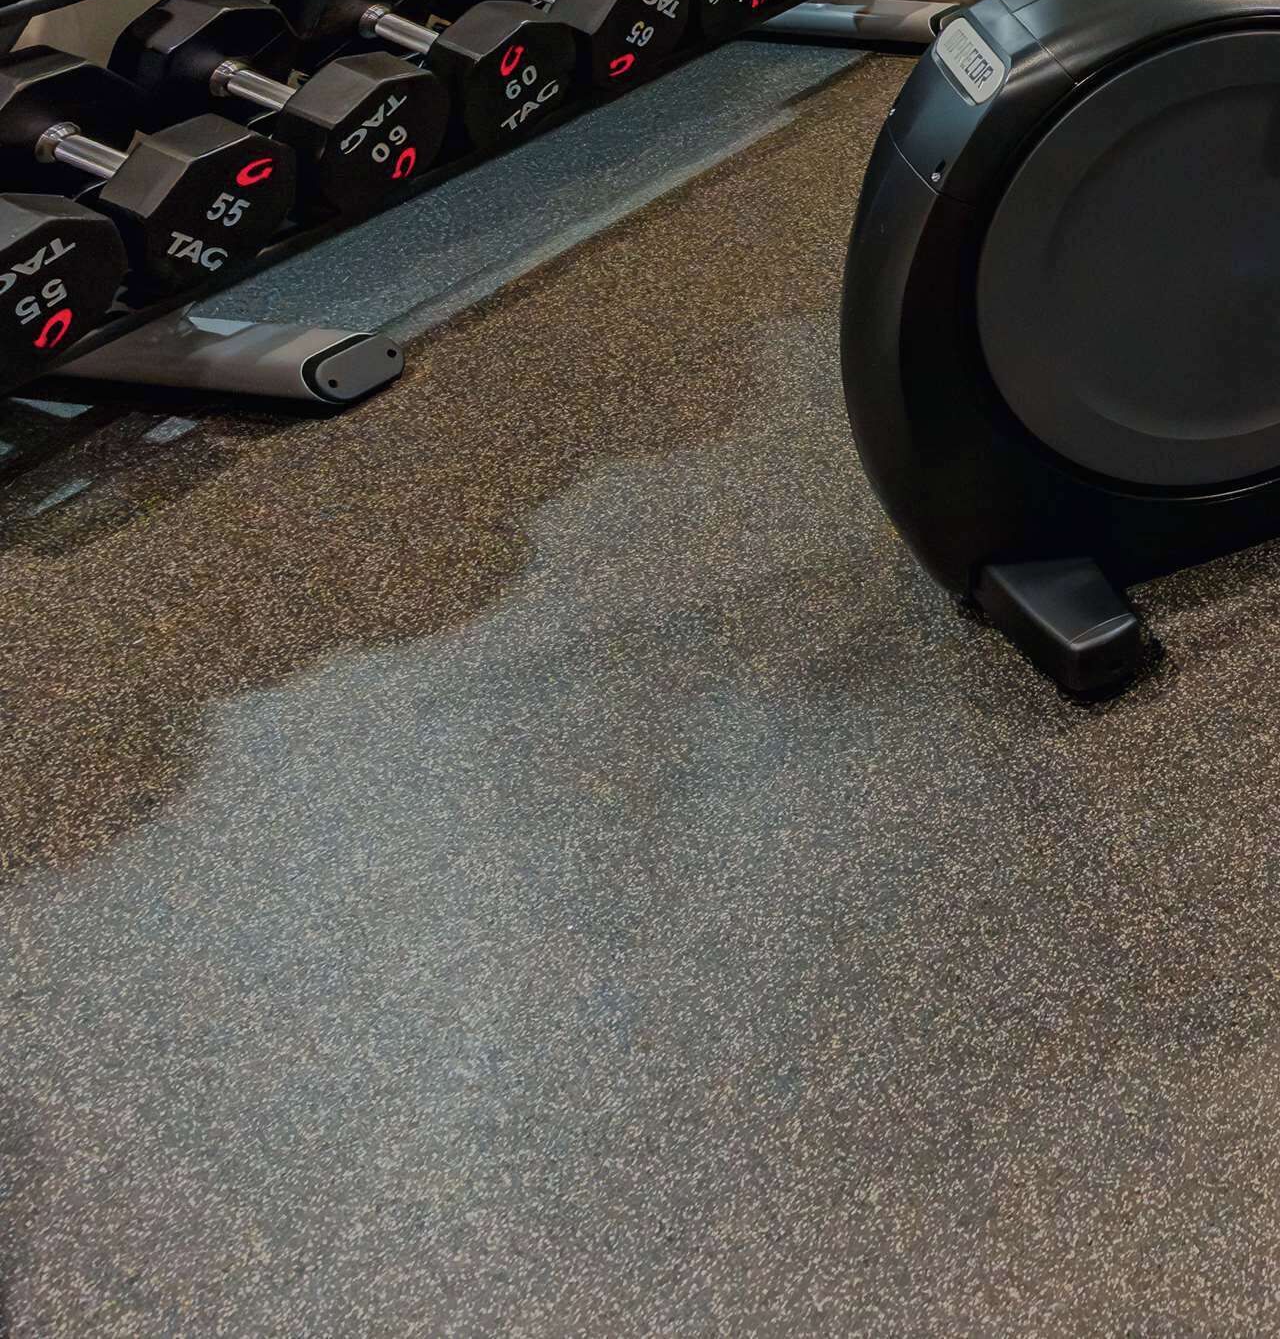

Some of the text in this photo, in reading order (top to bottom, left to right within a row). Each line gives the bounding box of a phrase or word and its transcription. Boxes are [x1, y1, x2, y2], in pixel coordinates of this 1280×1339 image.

[625, 20, 655, 47] 65
[504, 64, 538, 100] 60
[340, 94, 408, 155] TAG
[500, 79, 560, 131] TAG
[371, 125, 408, 163] 60
[206, 192, 250, 227] 55
[167, 231, 228, 272] TAG
[15, 278, 67, 325] 55
